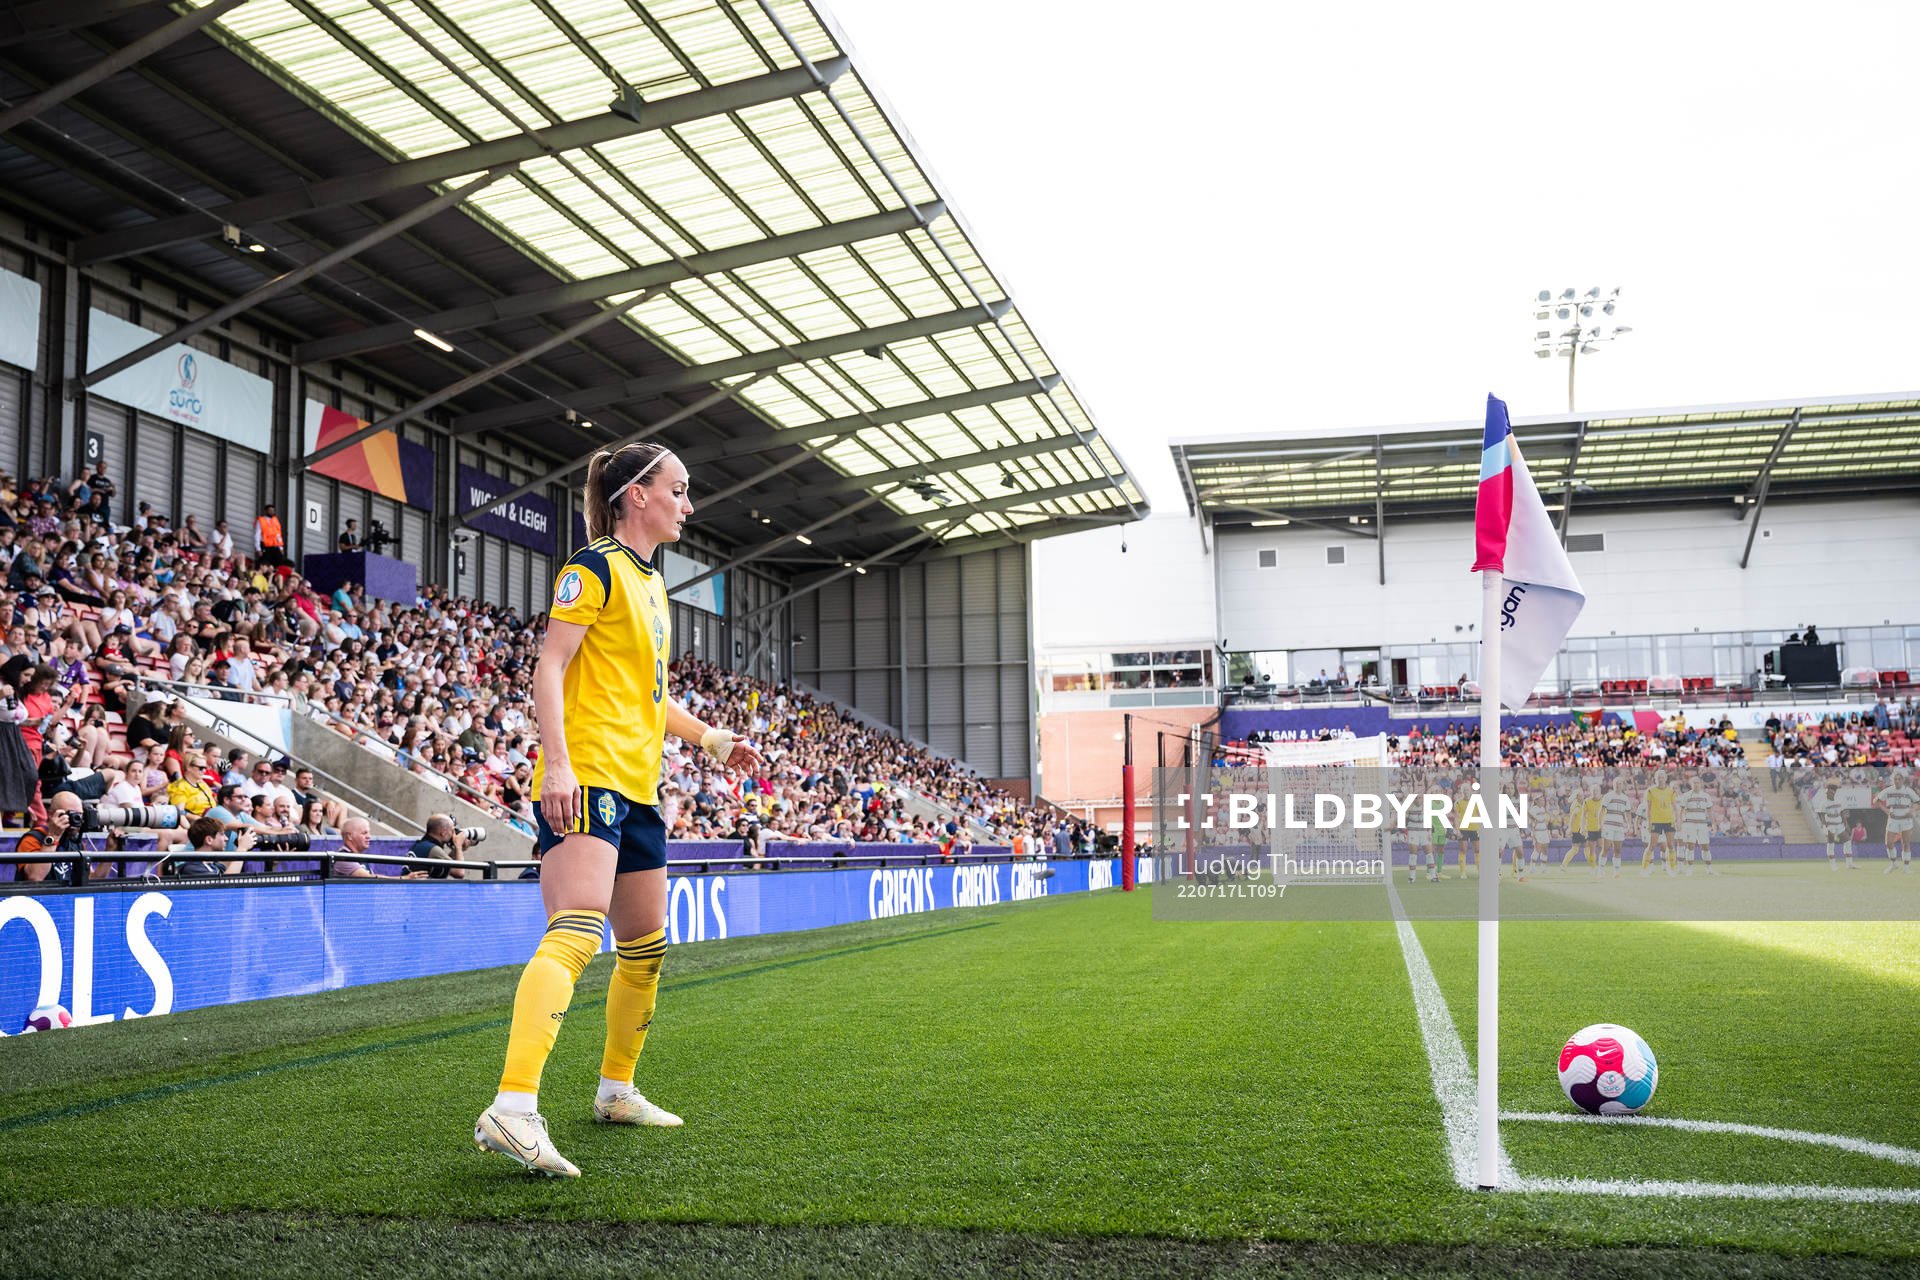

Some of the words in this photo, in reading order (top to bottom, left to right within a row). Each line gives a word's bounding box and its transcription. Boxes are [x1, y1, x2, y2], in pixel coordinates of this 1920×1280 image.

[88, 437, 98, 458] 3
[310, 508, 318, 523] D
[508, 502, 517, 522] &
[518, 506, 547, 534] LEIGH
[1501, 585, 1526, 632] gan
[653, 658, 663, 704] 9
[1299, 729, 1308, 740] &
[869, 867, 935, 920] GRIFOLS
[952, 864, 1000, 908] GRIFOLS
